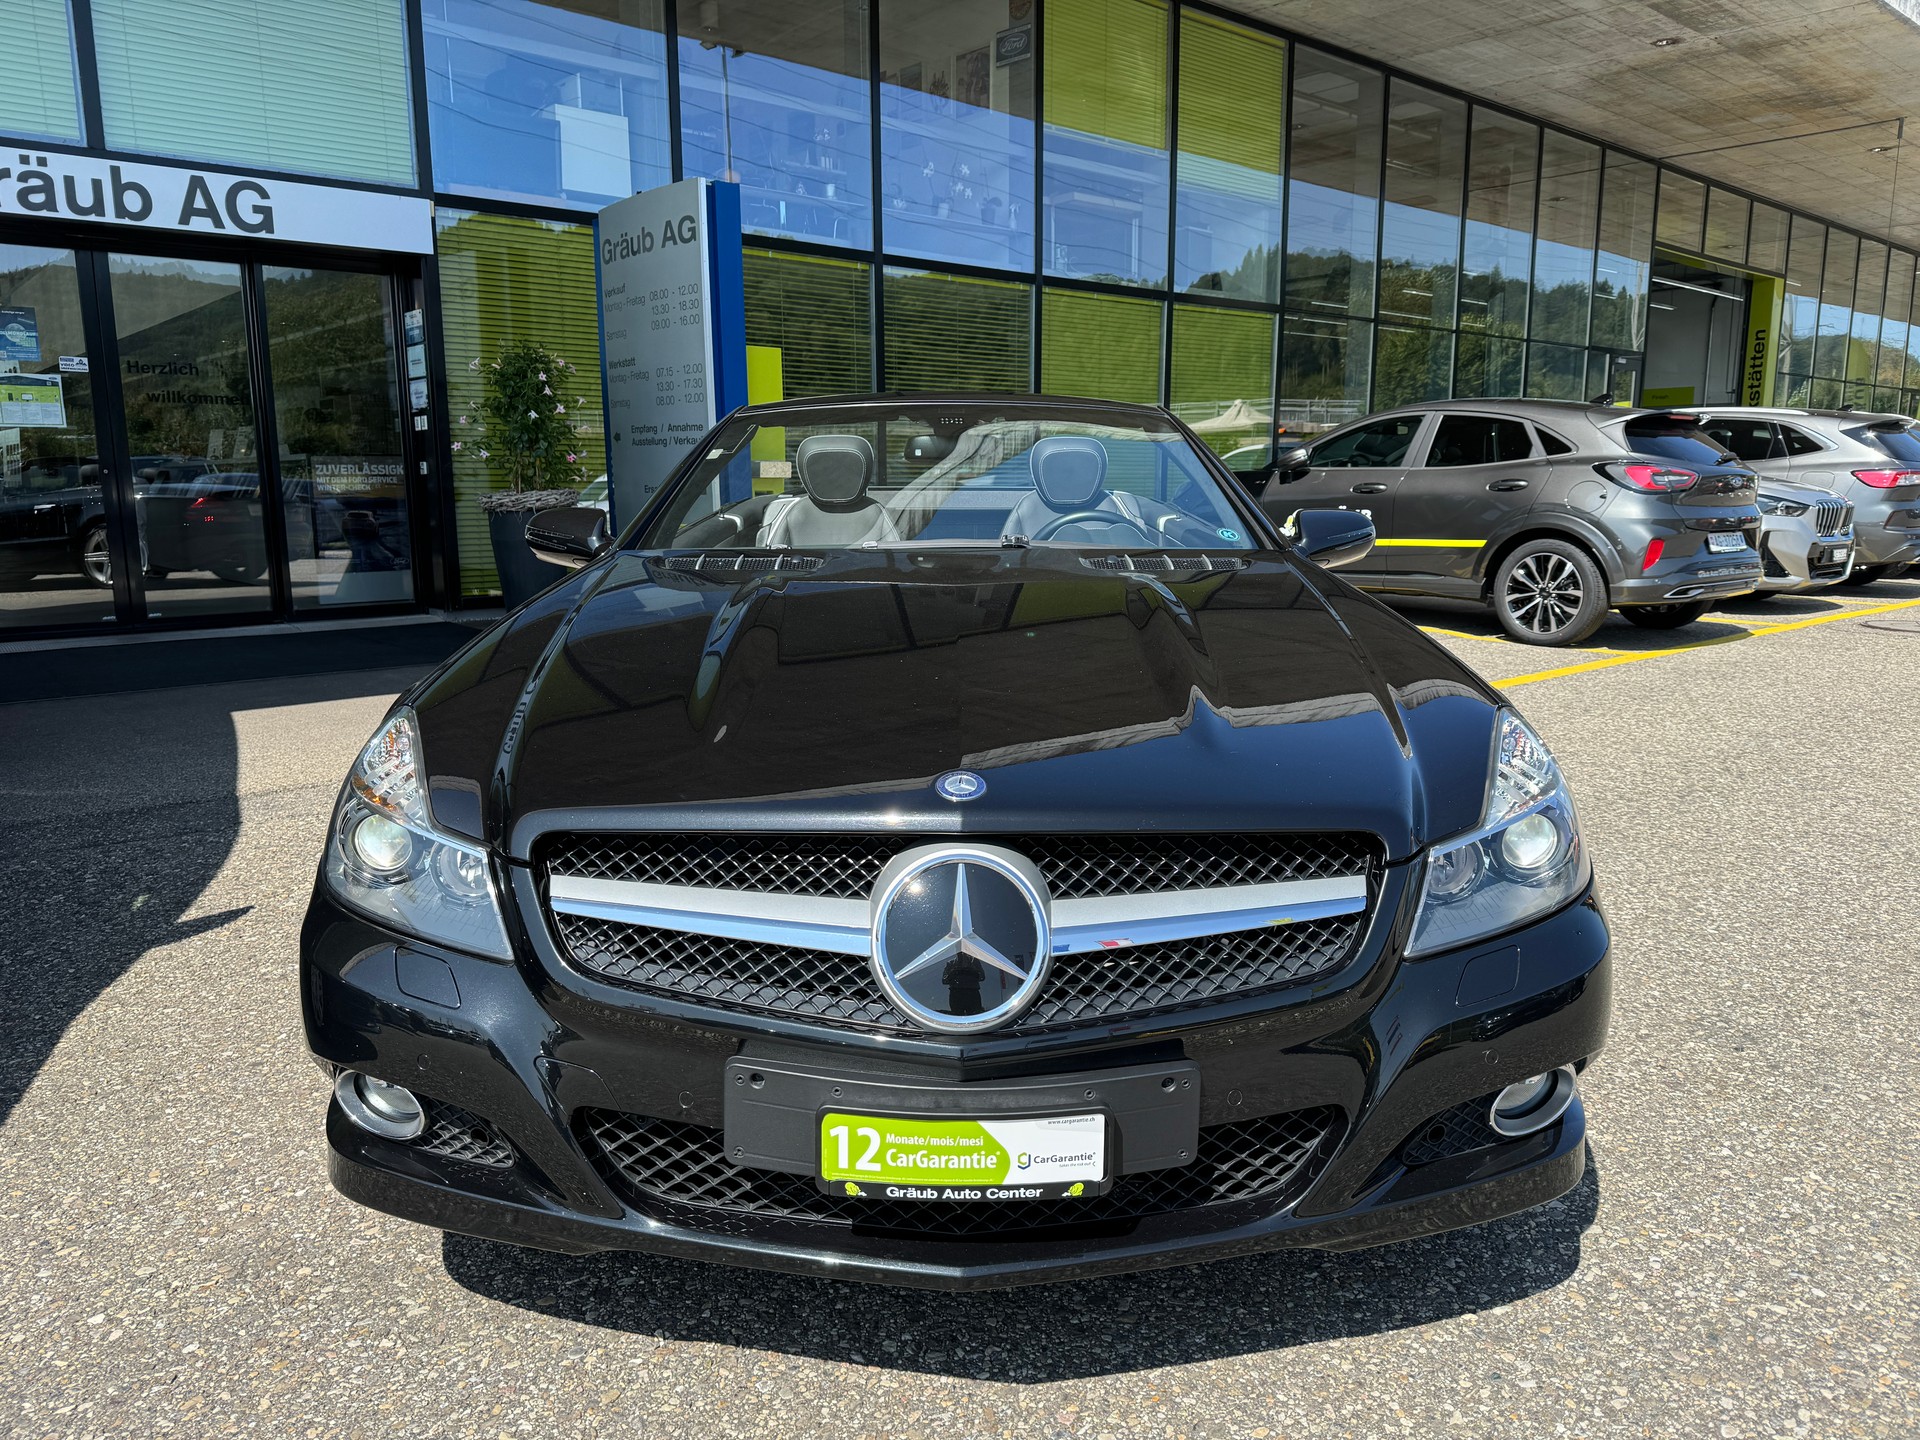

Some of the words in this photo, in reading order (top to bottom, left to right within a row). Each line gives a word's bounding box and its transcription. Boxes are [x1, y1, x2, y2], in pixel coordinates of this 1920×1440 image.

[178, 174, 275, 235] AG
[601, 226, 655, 265] Gräub
[661, 214, 697, 249] AG
[604, 282, 626, 299] Verkauf
[626, 295, 646, 307] Freitag
[649, 288, 669, 302] 08.00
[678, 283, 699, 296] 12.00
[652, 303, 670, 316] 13.30
[679, 298, 700, 311] 18.30
[651, 318, 671, 331] 09.00
[680, 313, 700, 326] 16.00
[126, 360, 199, 376] Herzlich
[608, 357, 636, 370] Werkstatt
[630, 370, 650, 381] Freitag
[656, 366, 674, 378] 07.15
[683, 363, 703, 374] 12.00
[657, 381, 675, 393] 13.30
[684, 377, 703, 389] 17.30
[656, 395, 675, 406] 08.00
[684, 392, 704, 404] 12.00
[631, 424, 658, 434] Empfang
[668, 423, 704, 432] Annahme
[631, 437, 668, 447] Ausstellung
[673, 436, 703, 445] Verka
[315, 462, 404, 475] ZUVERLÄSSIGK
[316, 476, 330, 484] MIT
[331, 476, 347, 484] DEM
[348, 476, 367, 484] FORD
[367, 476, 397, 484] SERVICE
[1047, 1117, 1096, 1125] www.cargarantie.ch
[886, 1133, 984, 1147] Monate/mois/mesi
[829, 1125, 882, 1172] 12
[886, 1187, 938, 1199] Gräub
[942, 1188, 982, 1199] Auto
[986, 1188, 1043, 1199] Center
